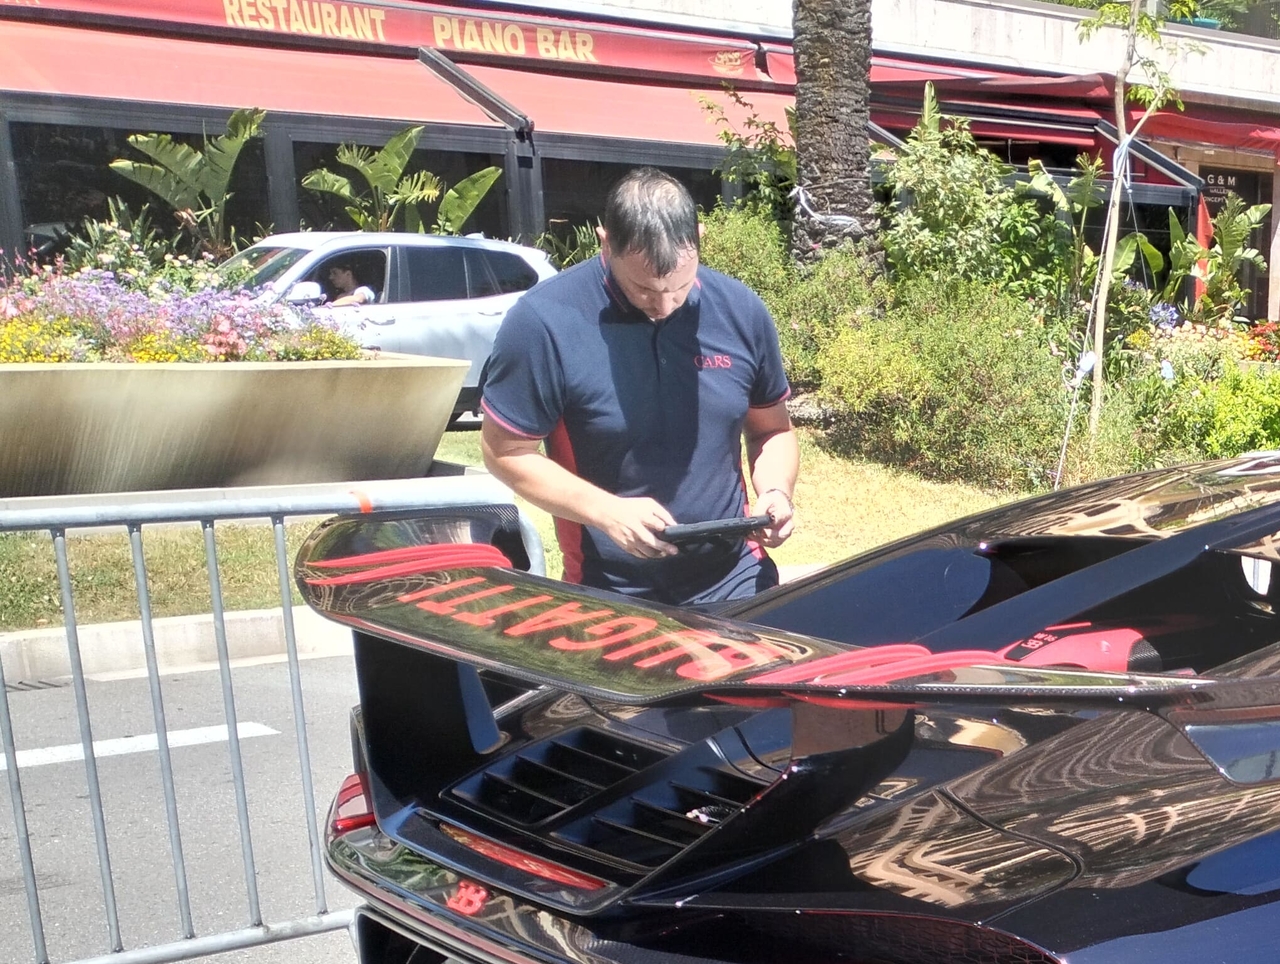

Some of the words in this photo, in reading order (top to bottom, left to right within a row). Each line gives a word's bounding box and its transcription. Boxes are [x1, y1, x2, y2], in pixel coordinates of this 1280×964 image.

[223, 0, 386, 42] RESTAURANT
[432, 16, 525, 55] PIANO
[536, 28, 598, 62] BAR
[1207, 174, 1215, 184] G
[1217, 175, 1225, 185] &
[1227, 176, 1236, 186] M
[694, 355, 732, 368] CARS
[397, 577, 782, 681] BUGATTI
